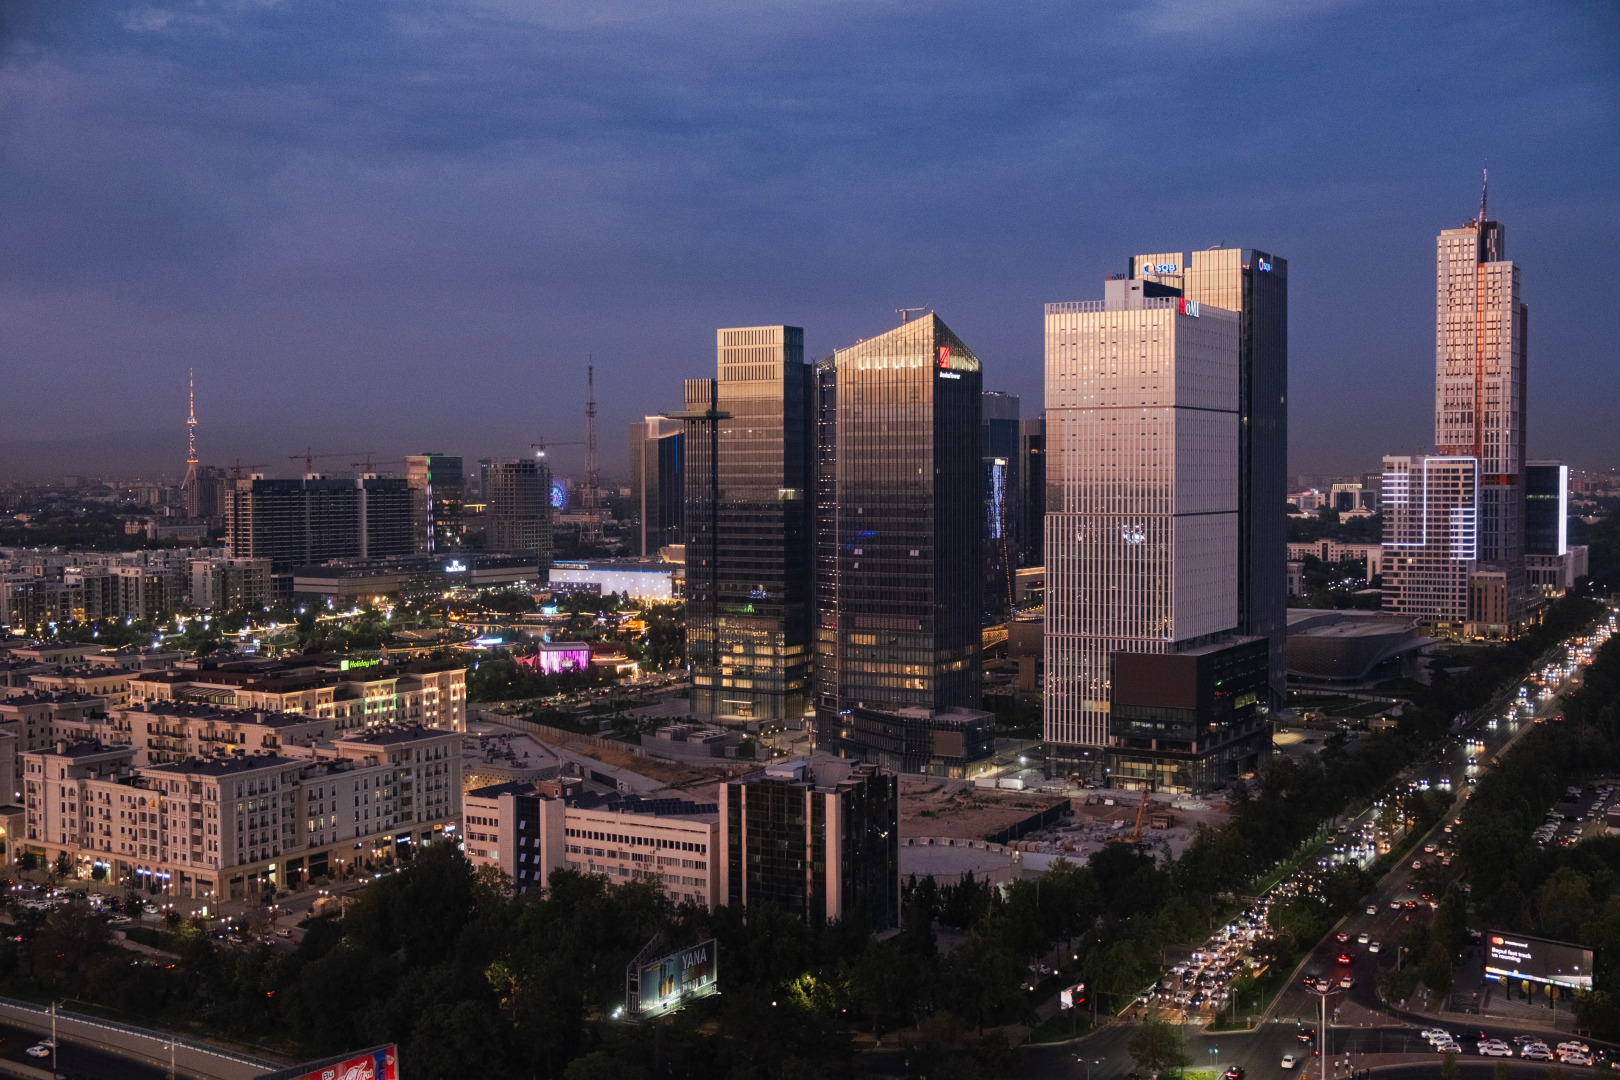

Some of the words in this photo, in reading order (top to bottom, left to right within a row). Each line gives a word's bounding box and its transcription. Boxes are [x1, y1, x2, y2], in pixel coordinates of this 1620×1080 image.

[1156, 264, 1176, 273] SQB
[350, 660, 369, 668] Holiday
[682, 948, 706, 969] YANA
